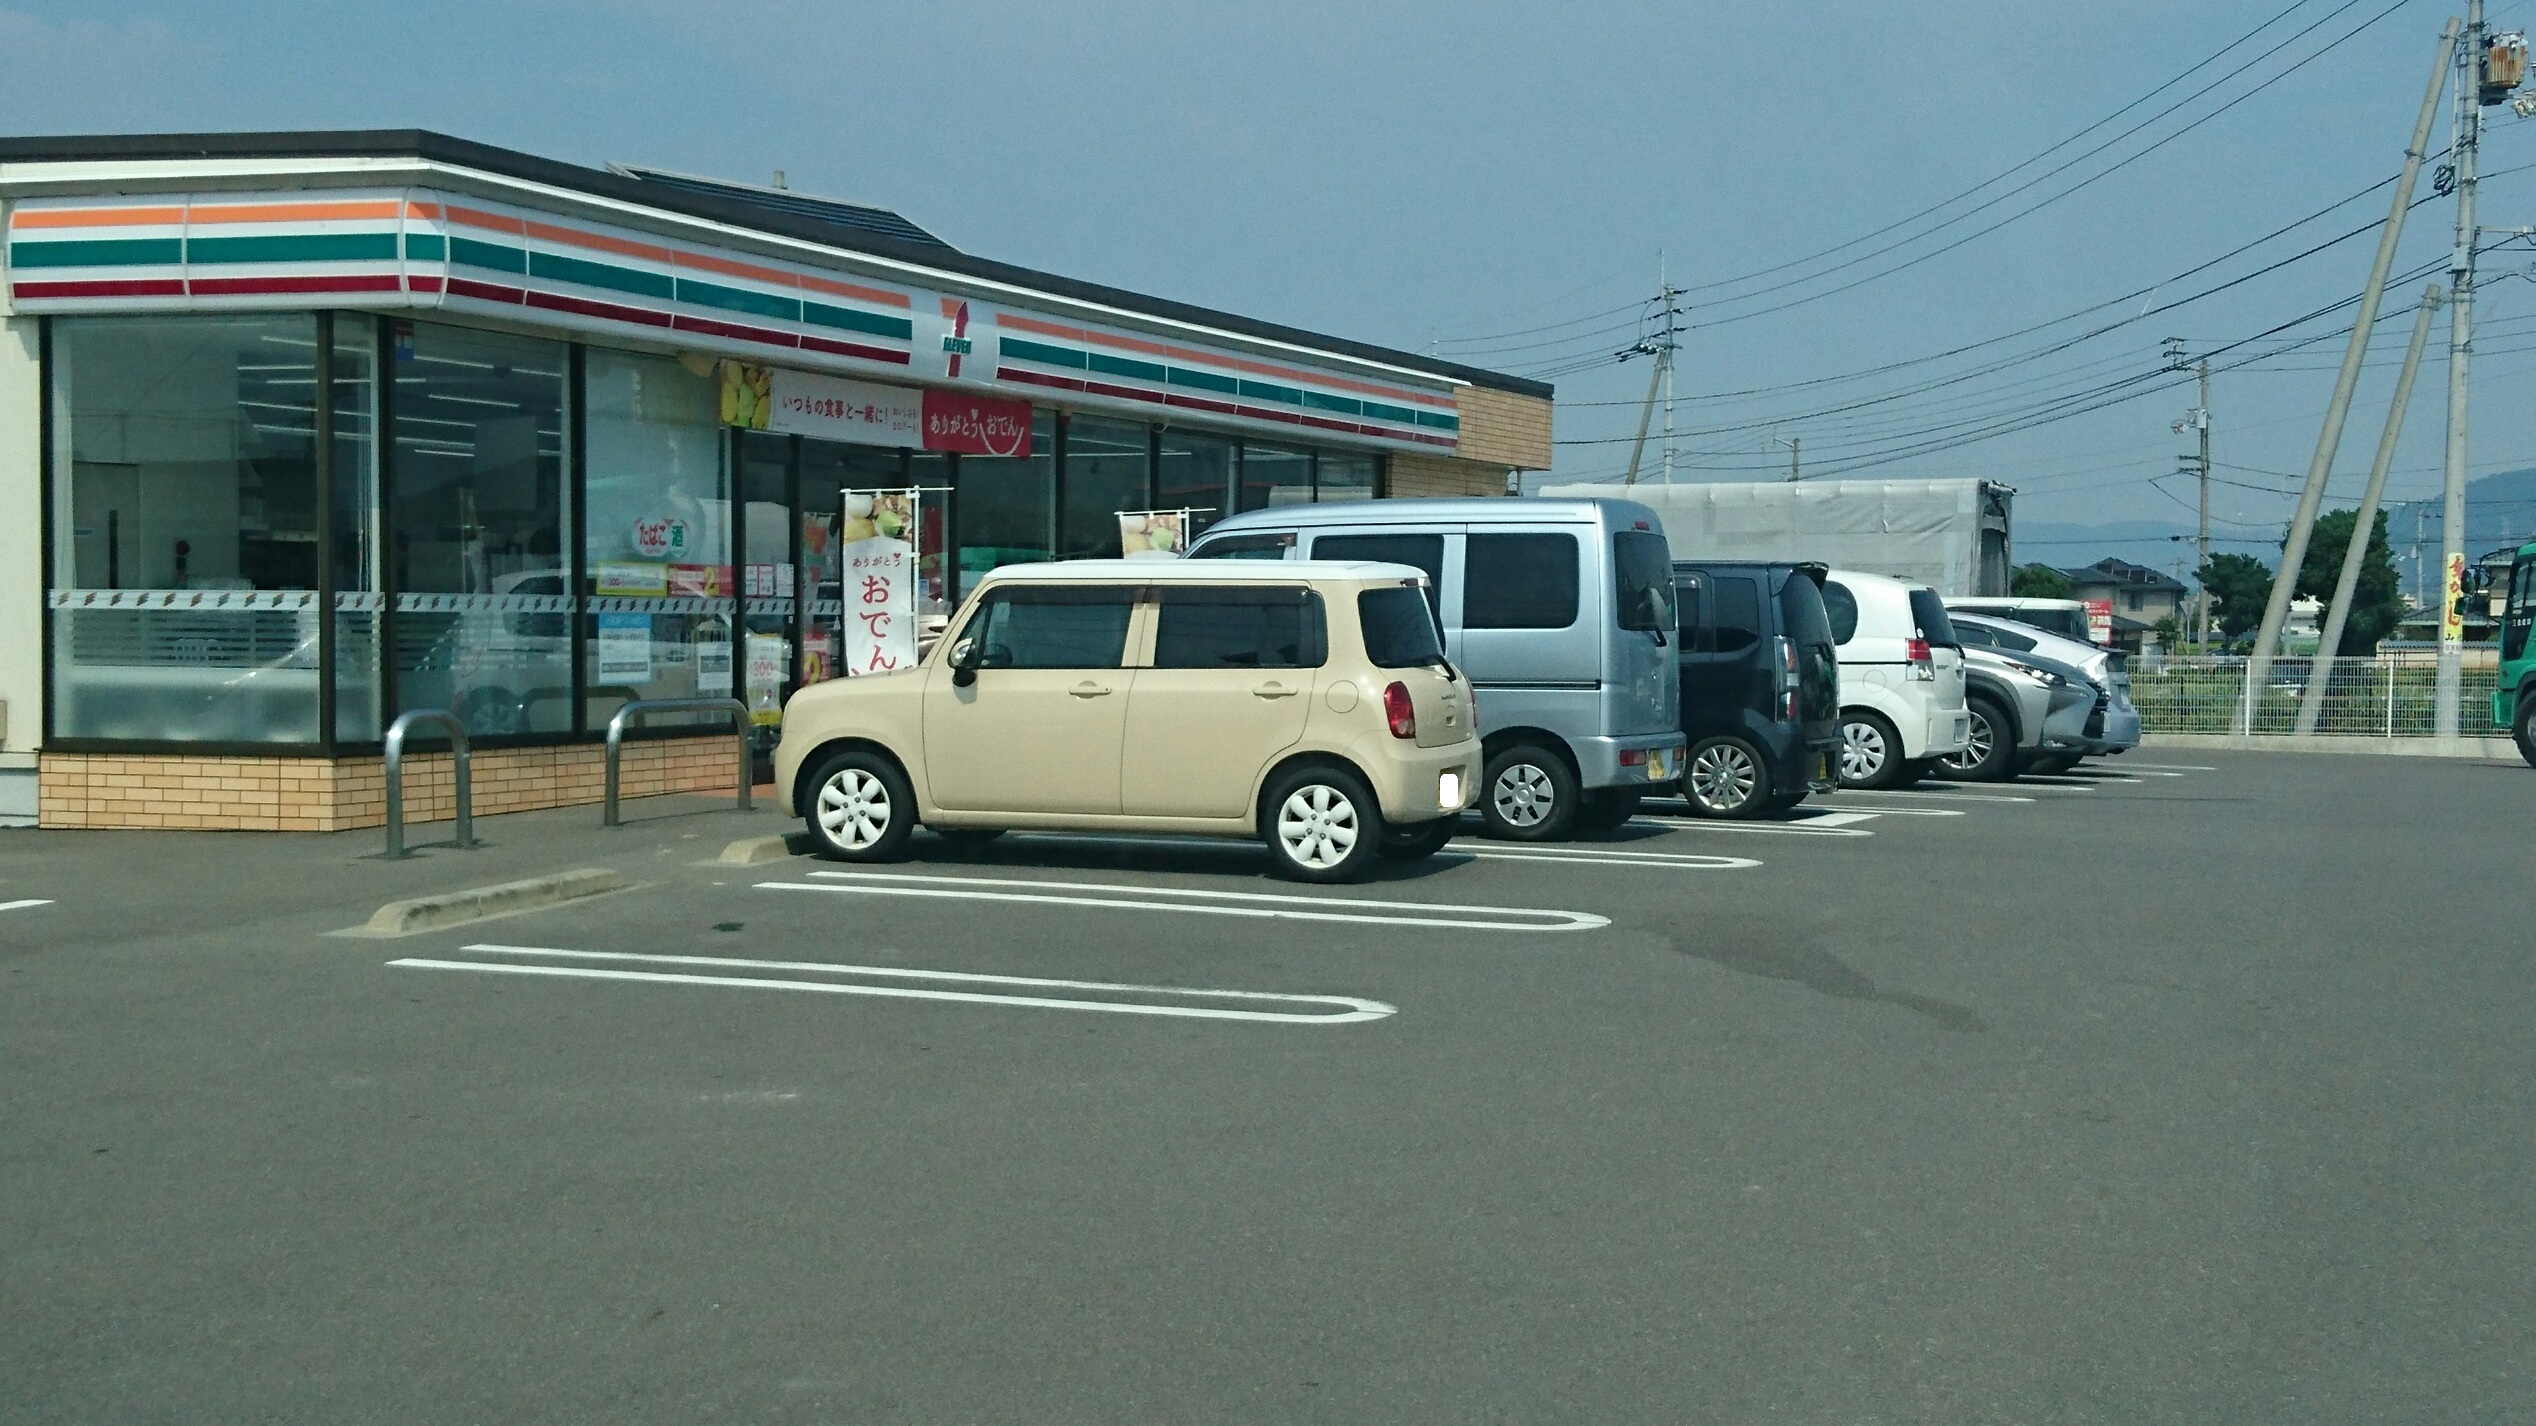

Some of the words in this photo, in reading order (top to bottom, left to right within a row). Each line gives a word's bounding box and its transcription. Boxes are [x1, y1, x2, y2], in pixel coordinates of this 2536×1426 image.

[941, 297, 969, 377] 7
[930, 408, 978, 437] ありがとう
[987, 413, 1019, 437] おでん
[639, 522, 668, 546] たばこ
[671, 525, 685, 547] 酒
[852, 553, 901, 568] ありがとう
[859, 574, 897, 672] おでん
